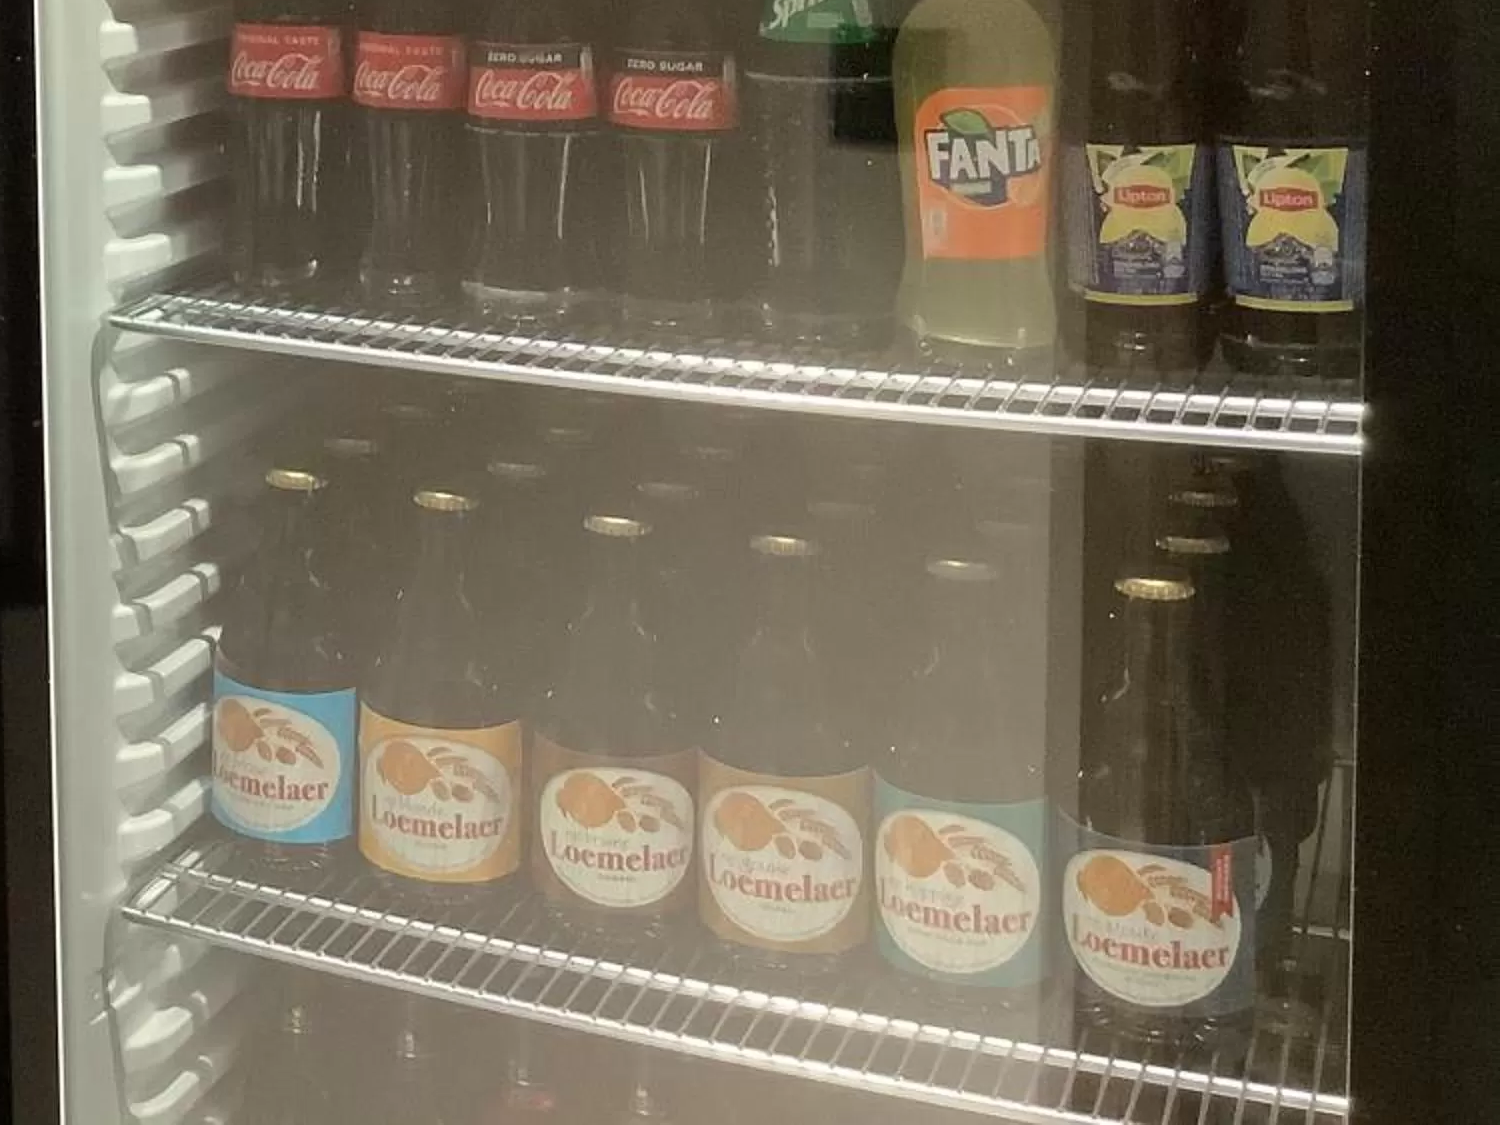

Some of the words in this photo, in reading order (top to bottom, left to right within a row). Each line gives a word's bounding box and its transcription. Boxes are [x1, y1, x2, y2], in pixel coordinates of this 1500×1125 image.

[487, 50, 517, 63] ZERO
[627, 58, 656, 72] ZERO
[659, 60, 704, 74] SUGAR
[925, 126, 1041, 181] FANTA
[1117, 187, 1169, 204] Lipton
[1262, 191, 1314, 208] Lipton
[372, 795, 504, 840] Loemelaer
[551, 831, 688, 873] Loemelaer
[710, 853, 857, 903] Loemelaer
[880, 877, 1032, 935] Loemelaer
[1072, 913, 1230, 970] Loemelaer
